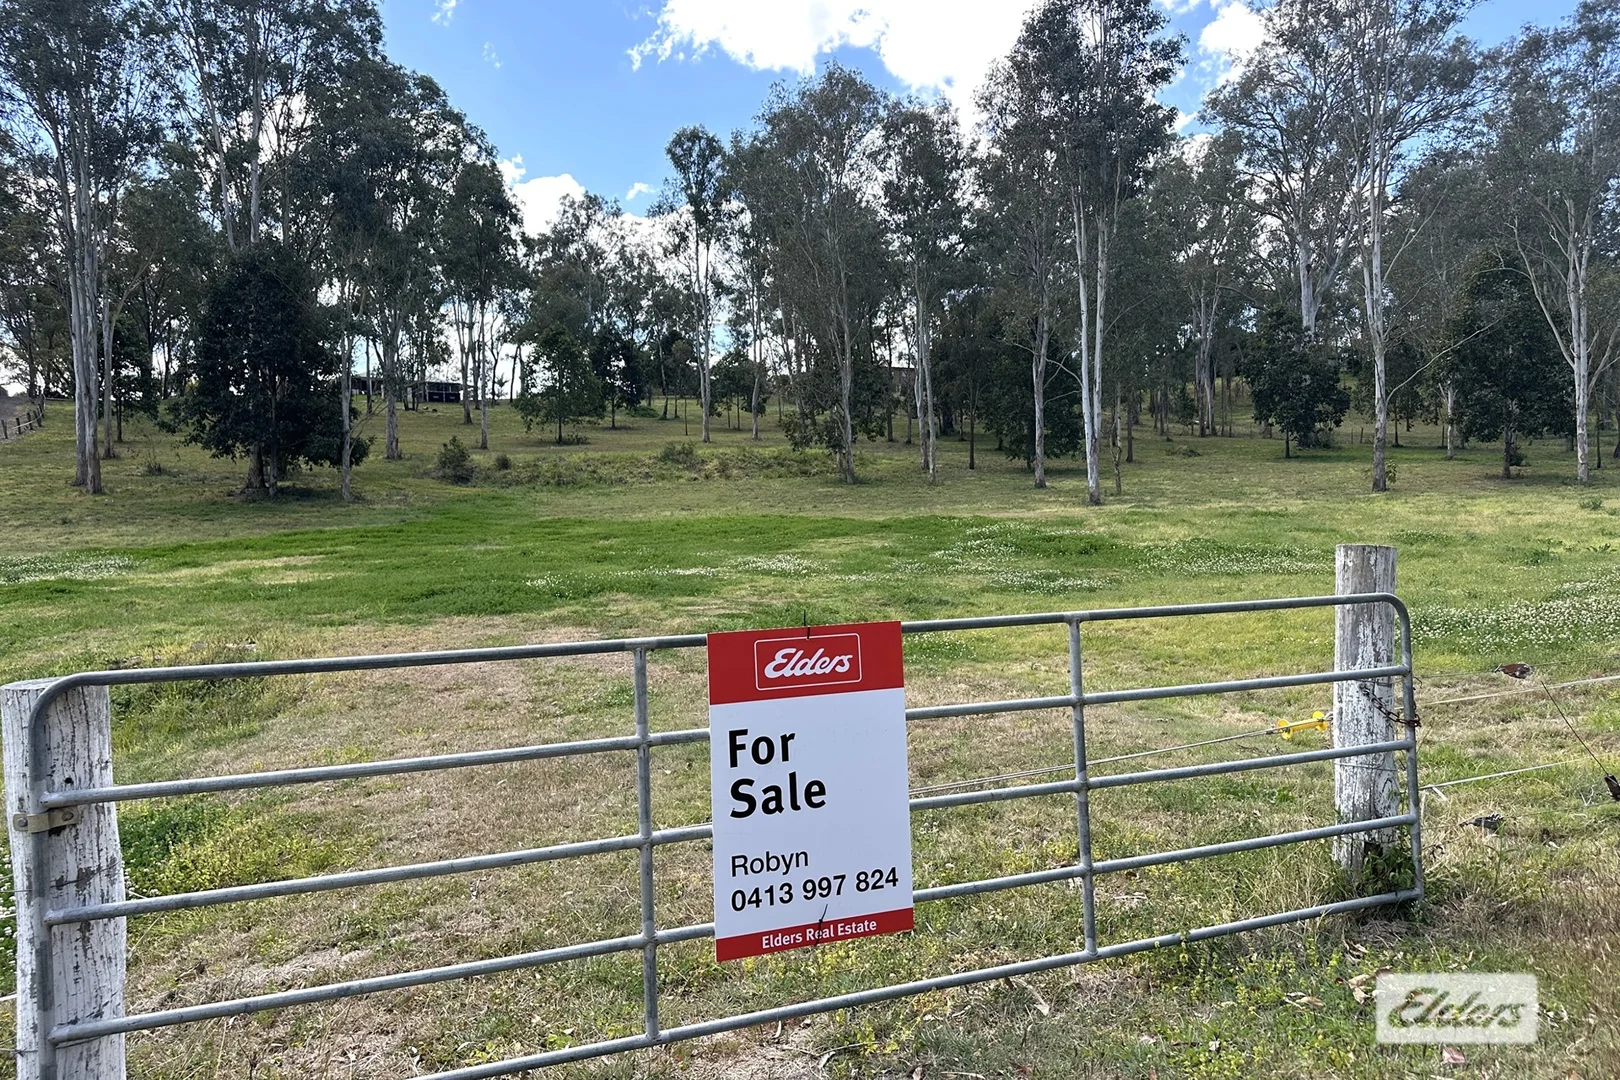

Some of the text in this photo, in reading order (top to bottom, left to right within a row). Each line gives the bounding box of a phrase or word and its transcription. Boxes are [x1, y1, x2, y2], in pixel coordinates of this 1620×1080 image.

[764, 648, 853, 679] Elders
[728, 728, 796, 768] For
[730, 771, 827, 819] Sale
[731, 850, 809, 877] Robyn
[731, 866, 899, 912] 0413 997 824
[761, 919, 877, 949] Elders Real Estate
